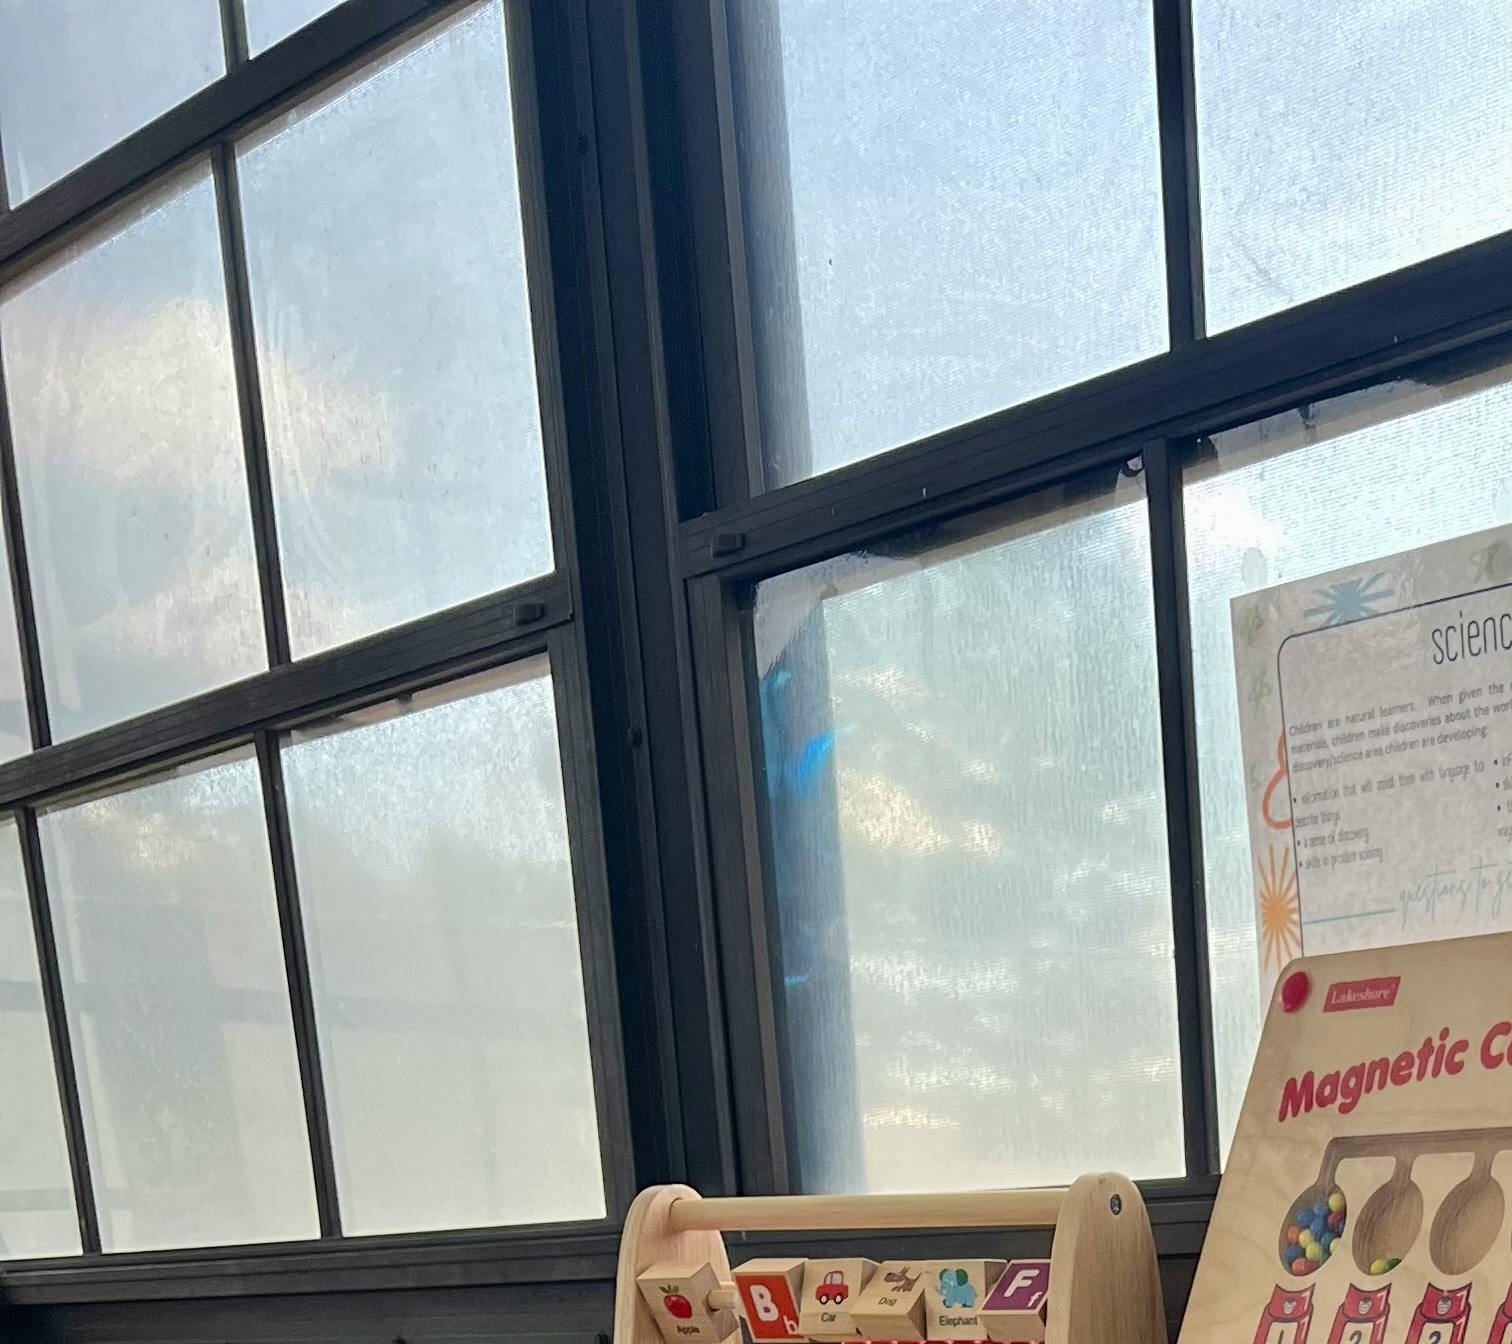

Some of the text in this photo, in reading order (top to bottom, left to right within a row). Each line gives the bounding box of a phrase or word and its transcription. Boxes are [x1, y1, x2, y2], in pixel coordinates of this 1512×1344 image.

[1278, 1026, 1469, 1122] Magnetic
[1003, 1269, 1040, 1298] F
[750, 1284, 779, 1322] B
[939, 1315, 978, 1327] Elephant
